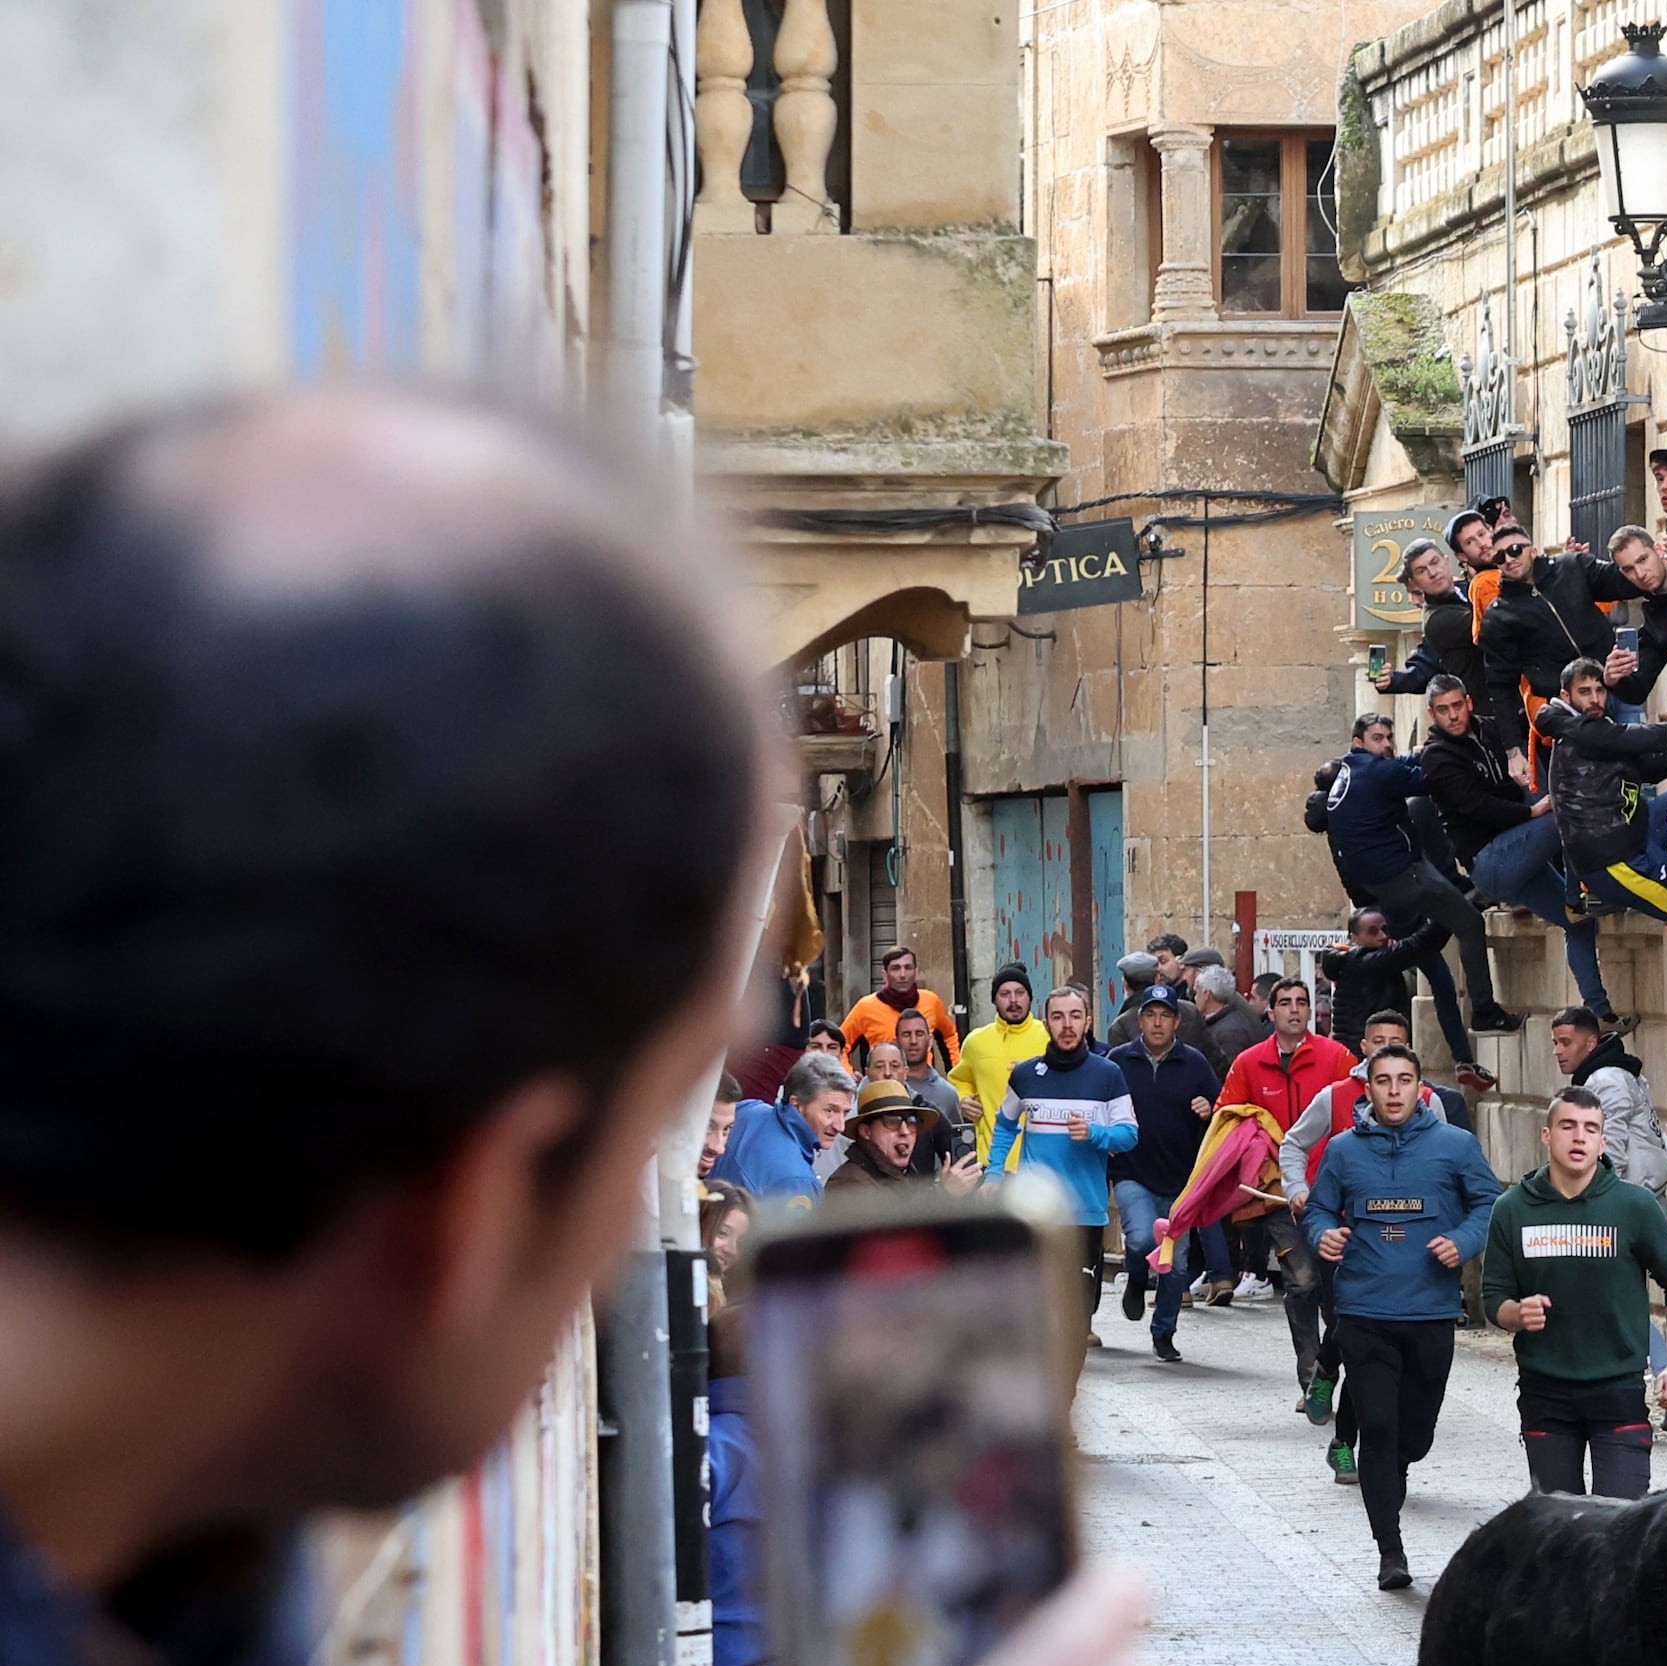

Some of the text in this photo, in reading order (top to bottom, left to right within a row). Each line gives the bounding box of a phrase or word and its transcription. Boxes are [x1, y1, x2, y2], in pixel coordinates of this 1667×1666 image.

[1363, 517, 1415, 538] Cajero
[1373, 590, 1413, 605] HO
[1040, 1103, 1098, 1121] humel
